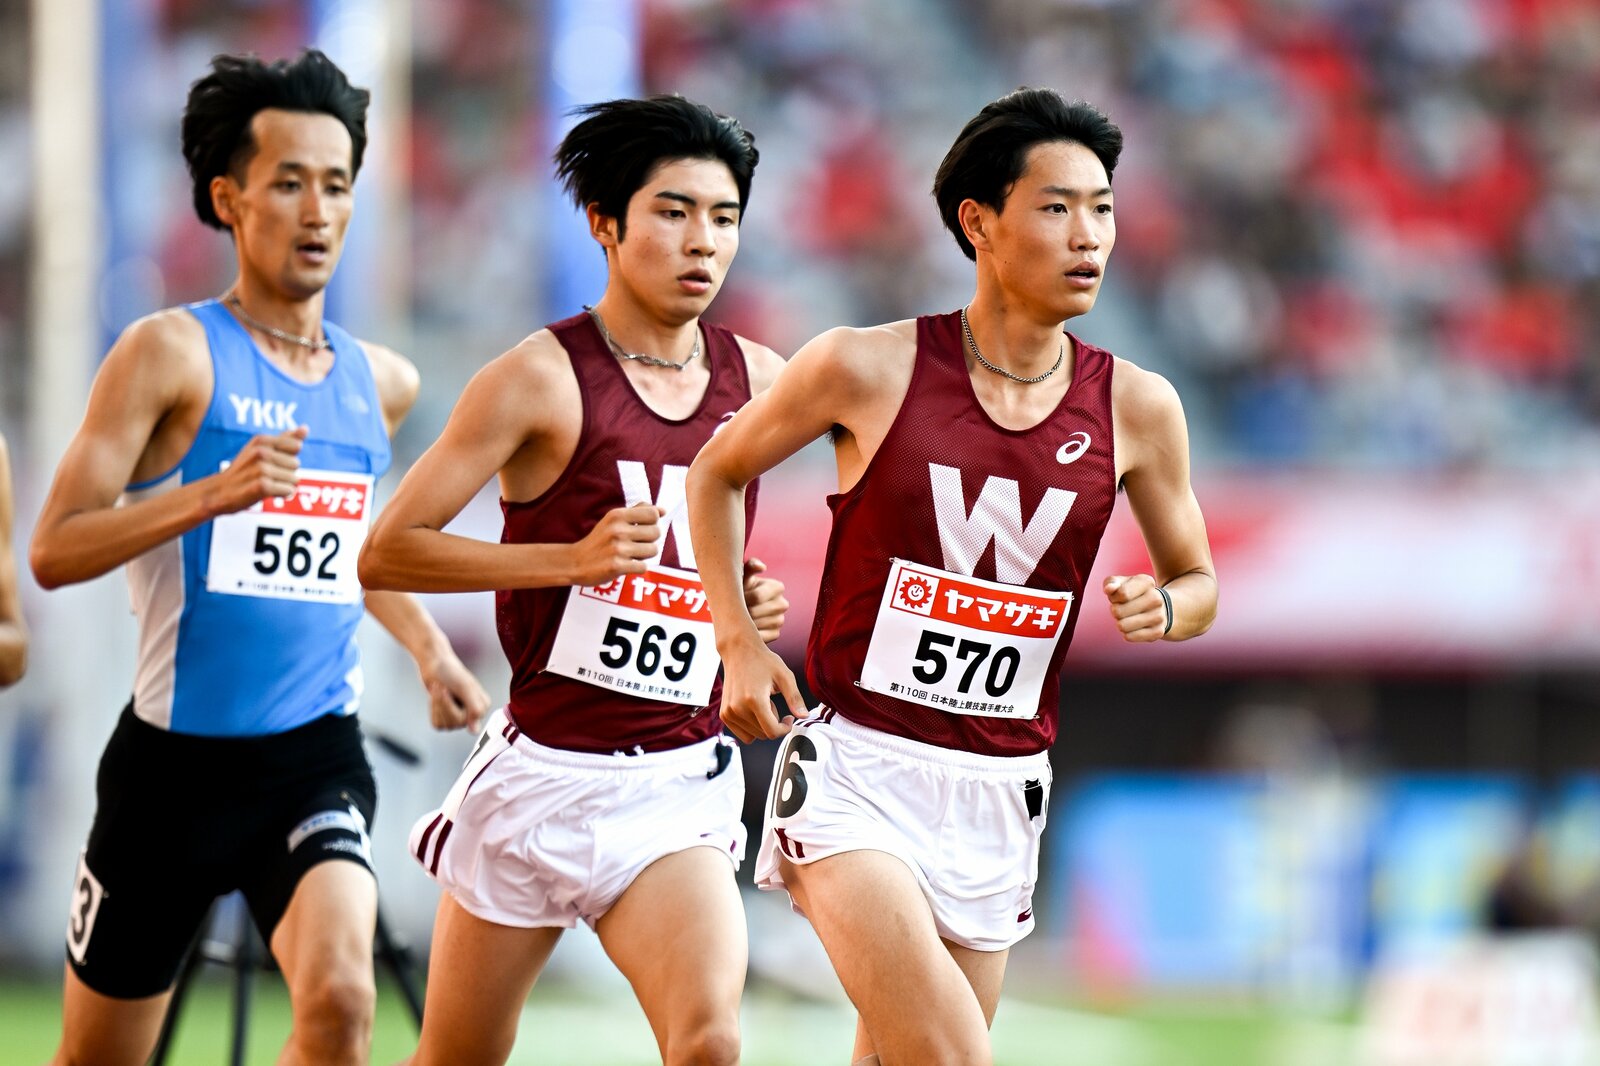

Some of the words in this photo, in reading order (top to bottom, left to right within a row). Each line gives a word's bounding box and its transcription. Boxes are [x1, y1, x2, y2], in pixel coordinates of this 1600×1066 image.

[229, 393, 298, 431] YKK
[253, 525, 341, 580] 562
[928, 462, 1079, 586] W
[944, 589, 1059, 630] ヤマザキ
[599, 616, 697, 682] 569
[912, 629, 1021, 698] 570
[889, 682, 928, 700] 第110回
[930, 693, 1015, 713] 日本陸上競技選手権大会
[71, 877, 93, 944] 3
